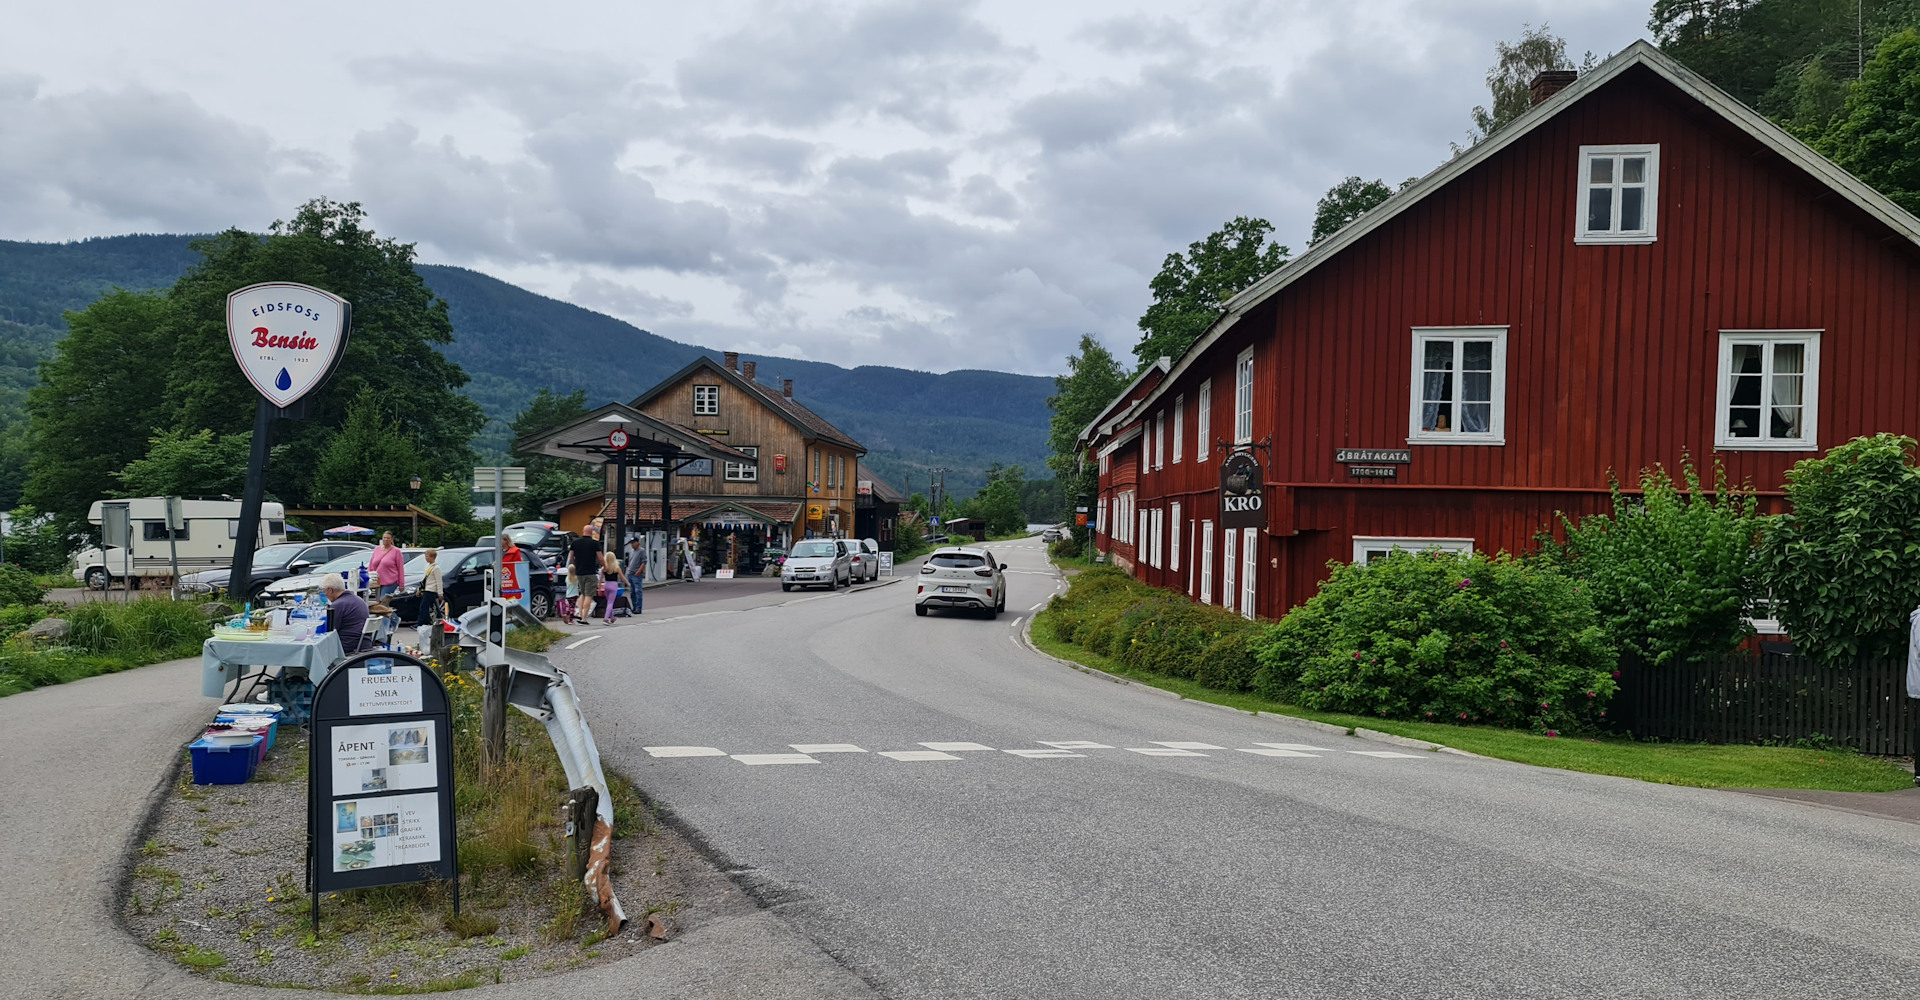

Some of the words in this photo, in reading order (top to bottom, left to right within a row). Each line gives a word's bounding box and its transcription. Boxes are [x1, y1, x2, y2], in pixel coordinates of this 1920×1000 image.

[251, 302, 320, 321] EIDSFOSS
[250, 326, 319, 350] Bensin
[1224, 495, 1262, 512] KRO
[361, 675, 398, 684] FRUENE
[401, 673, 415, 683] PÅ
[374, 689, 398, 698] SMIA
[338, 741, 375, 752] ÅPENT
[399, 826, 423, 834] GRAFIKK
[398, 834, 427, 842] KERAMIKK
